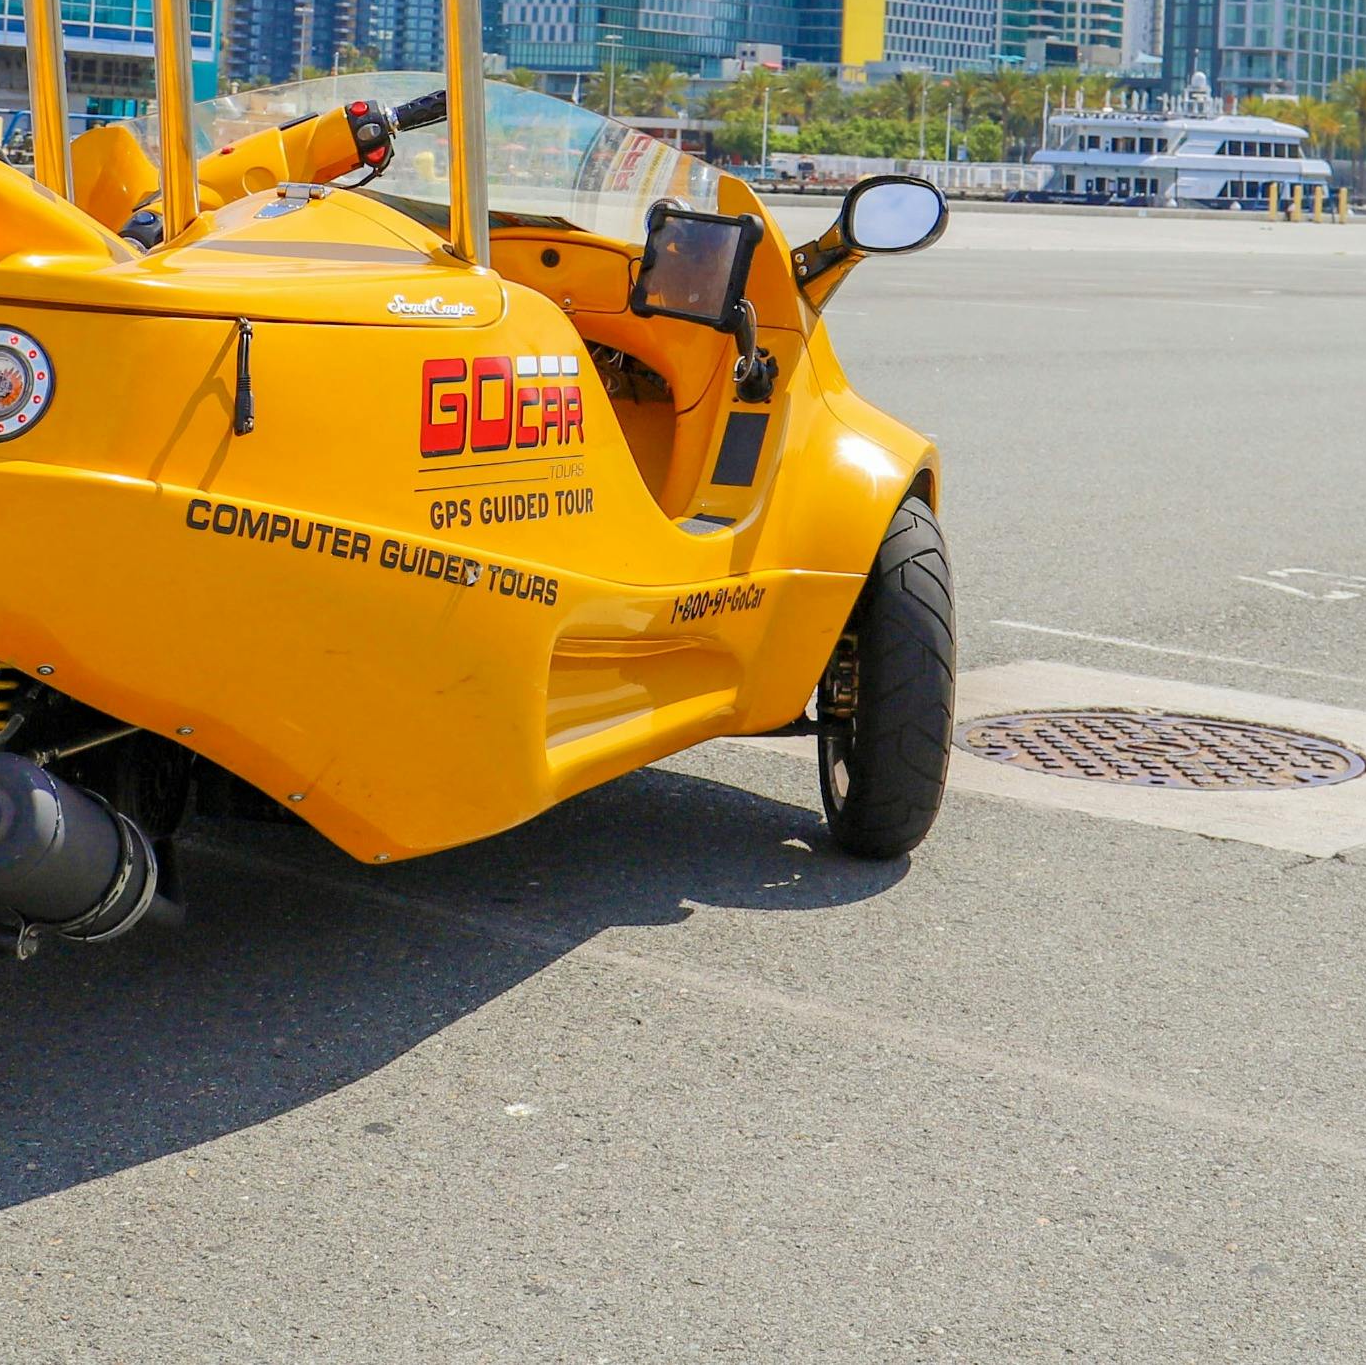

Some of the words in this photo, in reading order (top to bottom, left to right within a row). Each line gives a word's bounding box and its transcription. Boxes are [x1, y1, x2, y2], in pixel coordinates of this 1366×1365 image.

[549, 463, 584, 479] TOURS
[430, 498, 472, 530] GPS
[480, 492, 549, 525] GUIDED
[555, 487, 594, 517] TOUR
[186, 498, 371, 563] COMPUTER
[379, 538, 484, 587] GUIDED
[488, 564, 559, 607] TOURS
[670, 583, 767, 624] 1-800-91-GoCar
